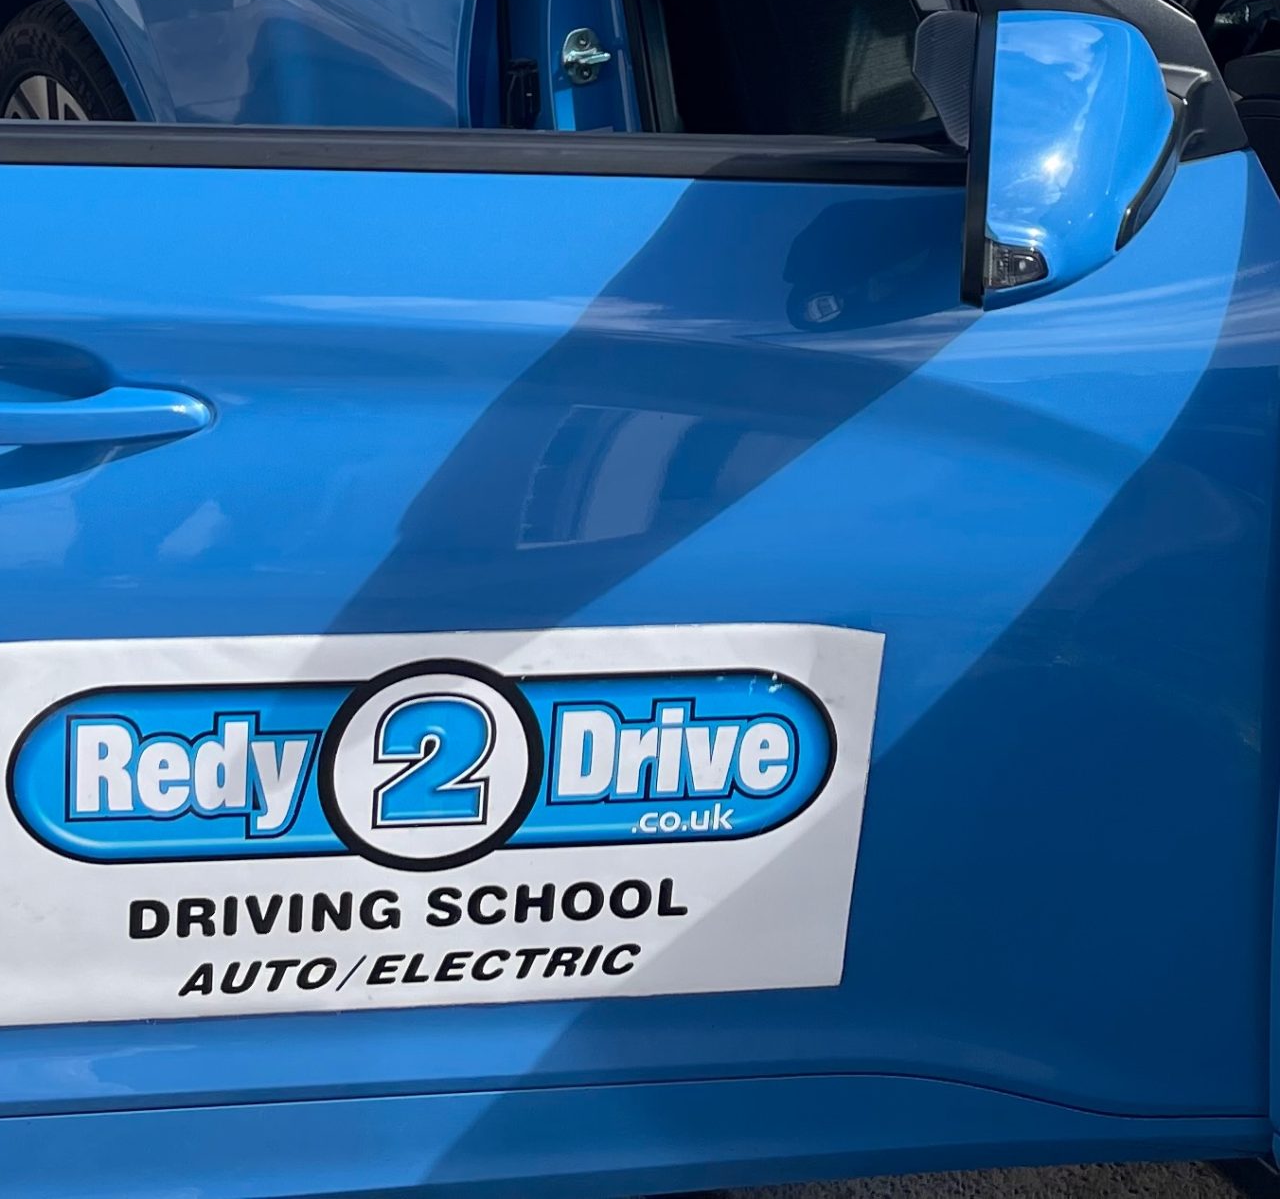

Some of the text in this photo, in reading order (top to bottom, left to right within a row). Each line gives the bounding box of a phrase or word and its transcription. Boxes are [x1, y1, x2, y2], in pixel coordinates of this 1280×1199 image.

[70, 693, 795, 835] Redy 2 Drive
[631, 803, 736, 834] .co.uk
[128, 877, 689, 940] DRIVING SCHOOL
[177, 942, 643, 998] AUTO/ELECTRIC
